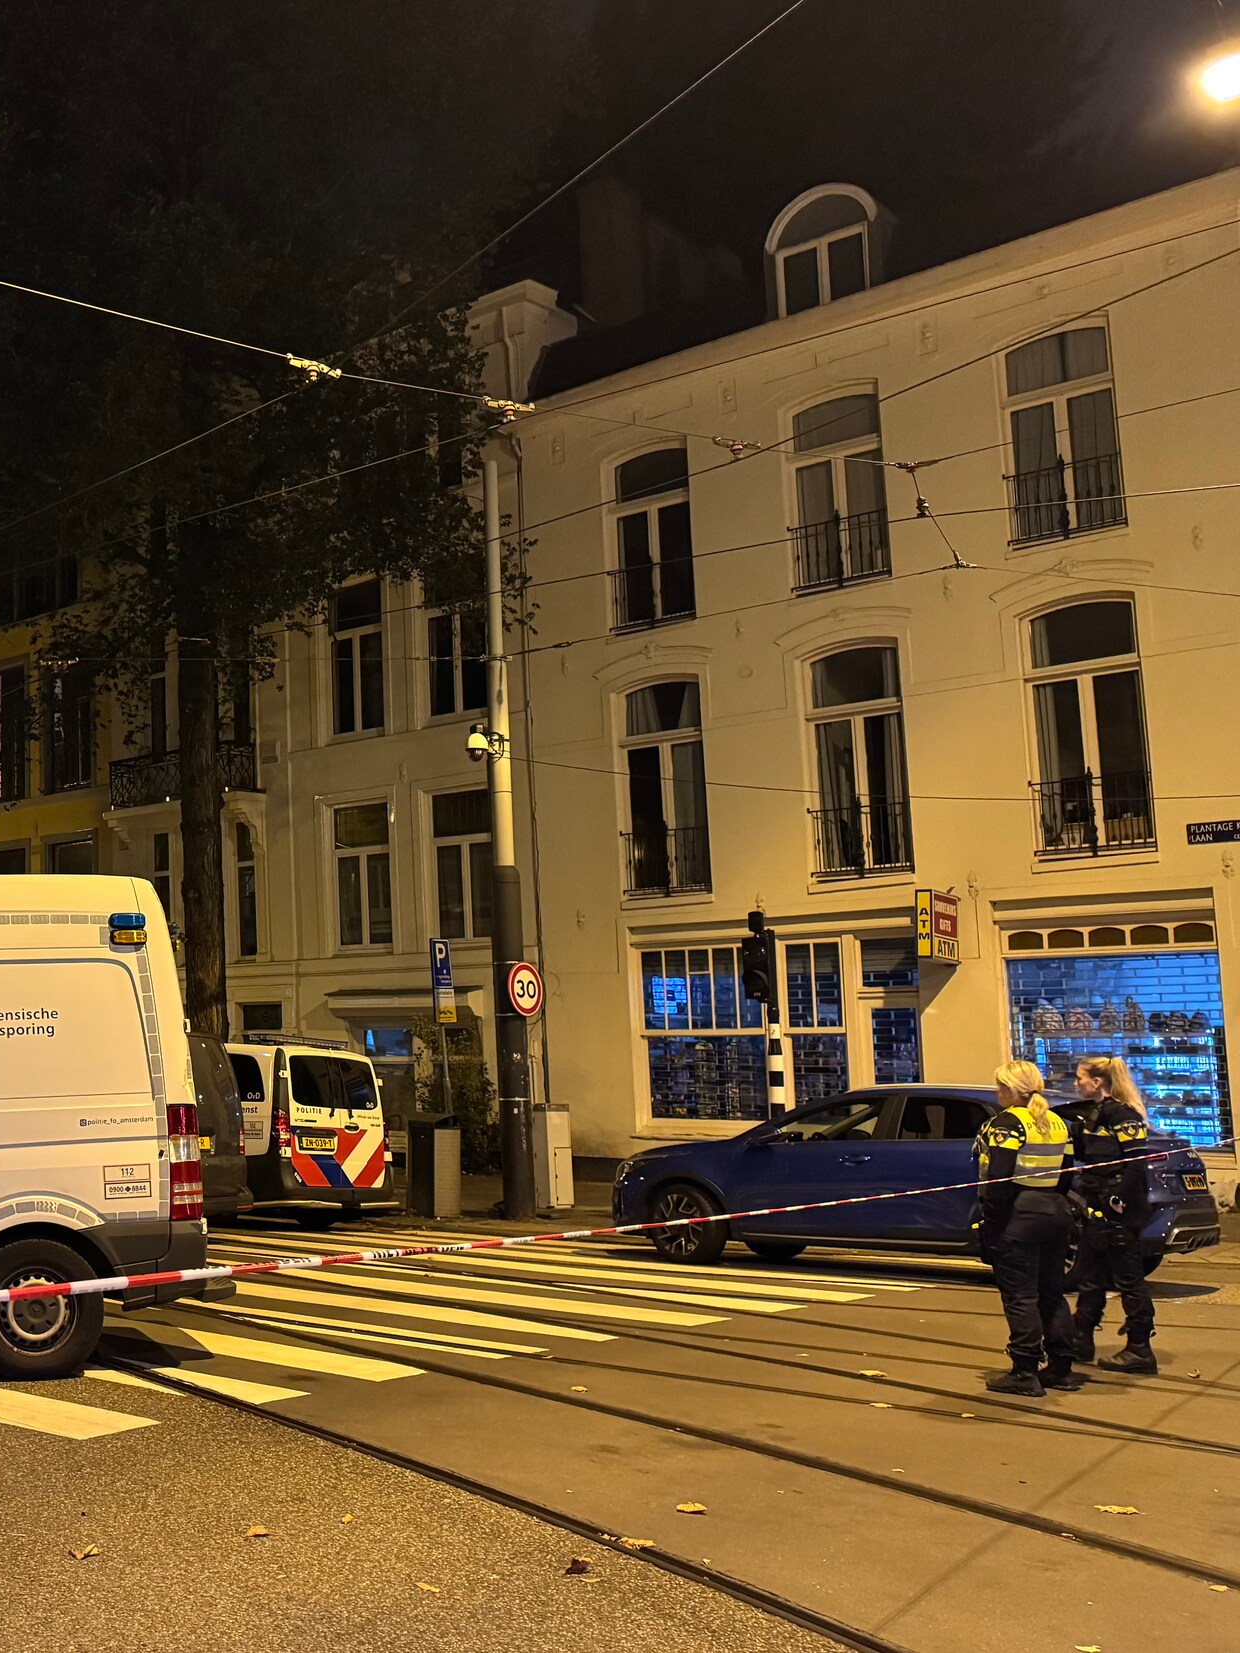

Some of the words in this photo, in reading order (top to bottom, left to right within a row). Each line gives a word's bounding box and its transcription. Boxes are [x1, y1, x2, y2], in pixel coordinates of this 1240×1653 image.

[1190, 822, 1234, 833] PLANTAGE
[1191, 833, 1213, 842] LAAN
[918, 907, 930, 940] ATM
[937, 939, 956, 959] ATM
[435, 943, 446, 968] P
[516, 979, 537, 999] 30
[296, 1107, 322, 1115] POLITIE
[87, 1116, 154, 1126] politie_fo_amsterdam
[120, 1167, 135, 1176] 112
